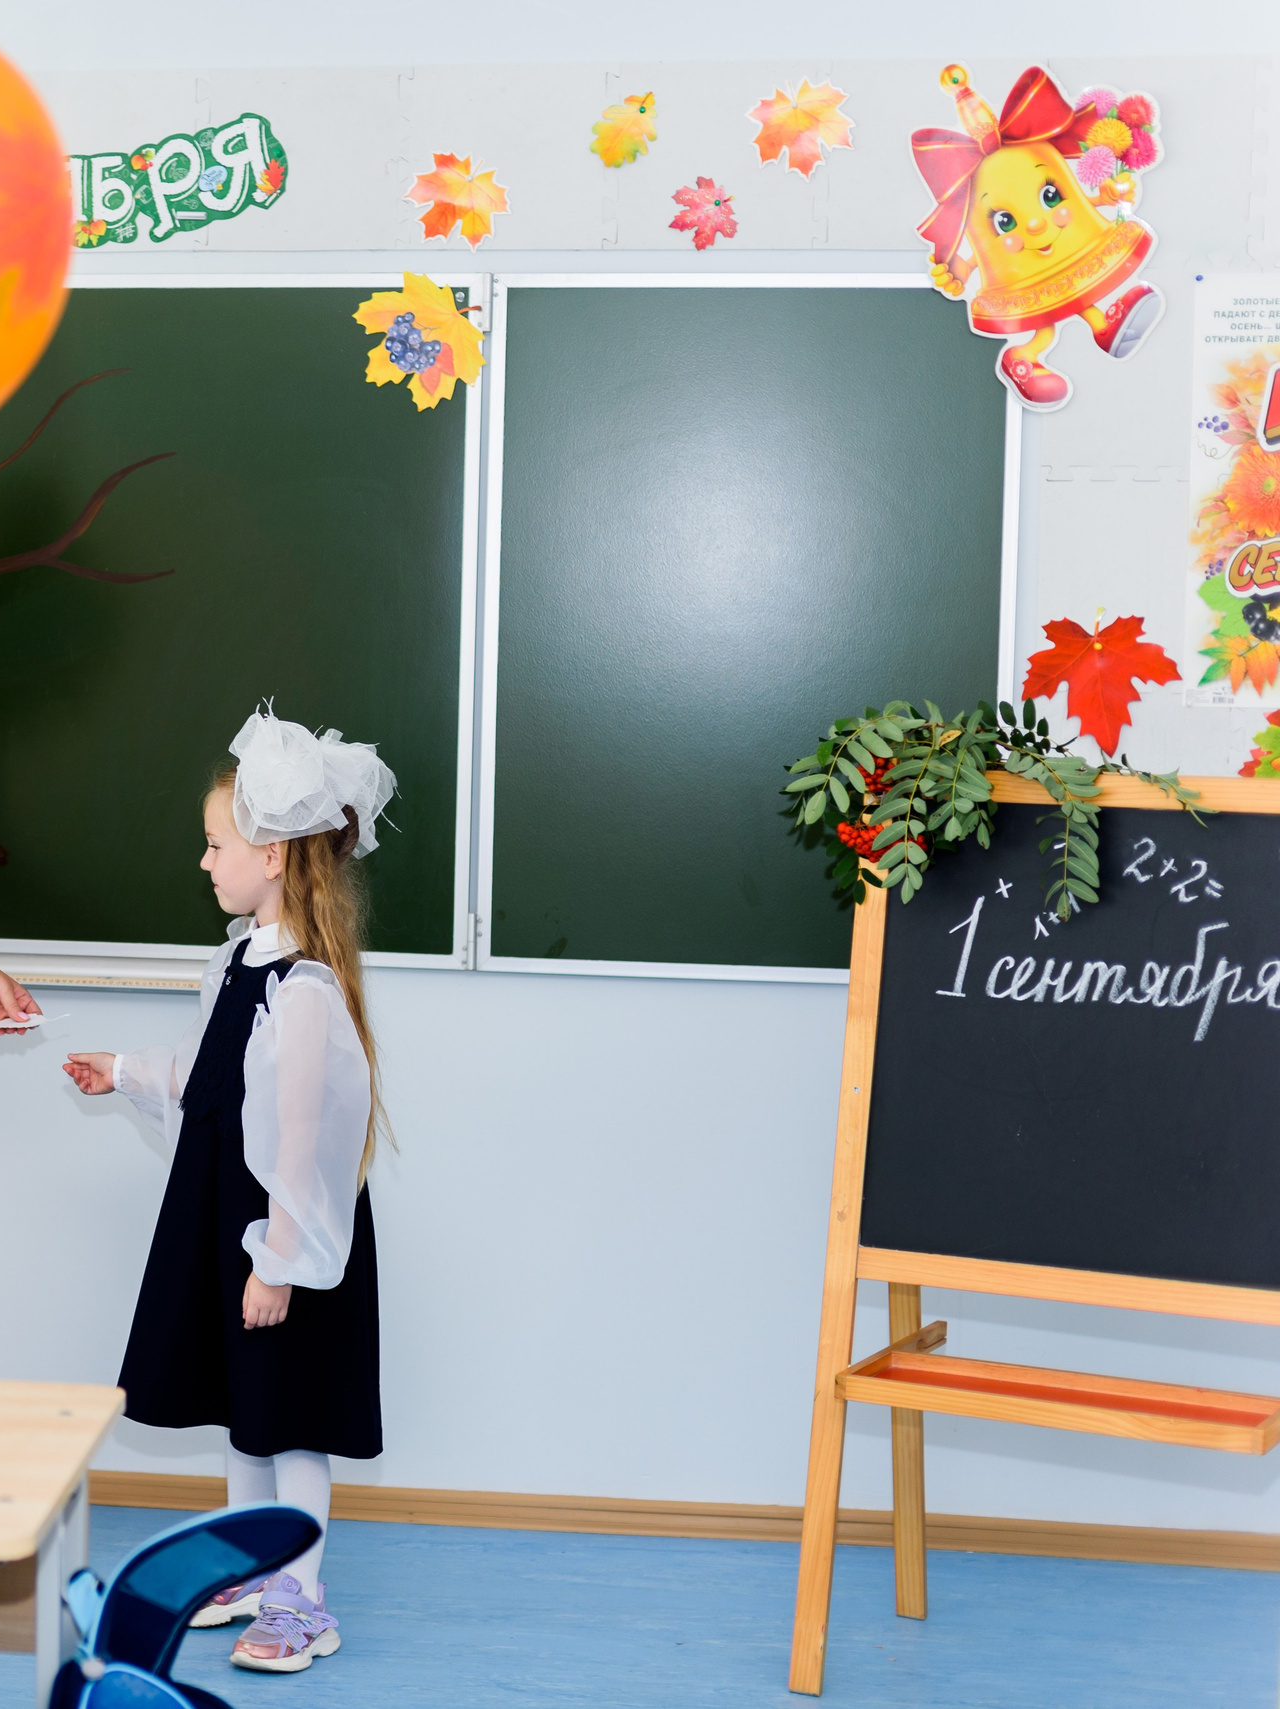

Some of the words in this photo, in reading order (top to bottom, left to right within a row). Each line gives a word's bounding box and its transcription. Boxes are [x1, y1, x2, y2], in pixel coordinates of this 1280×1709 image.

[67, 116, 277, 238] БРЯ
[1204, 335, 1264, 343] ОТКРЫВАЕТ
[1259, 310, 1266, 318] С
[1228, 541, 1280, 592] СЕ
[935, 895, 985, 997] 1
[985, 922, 1280, 1041] сентября
